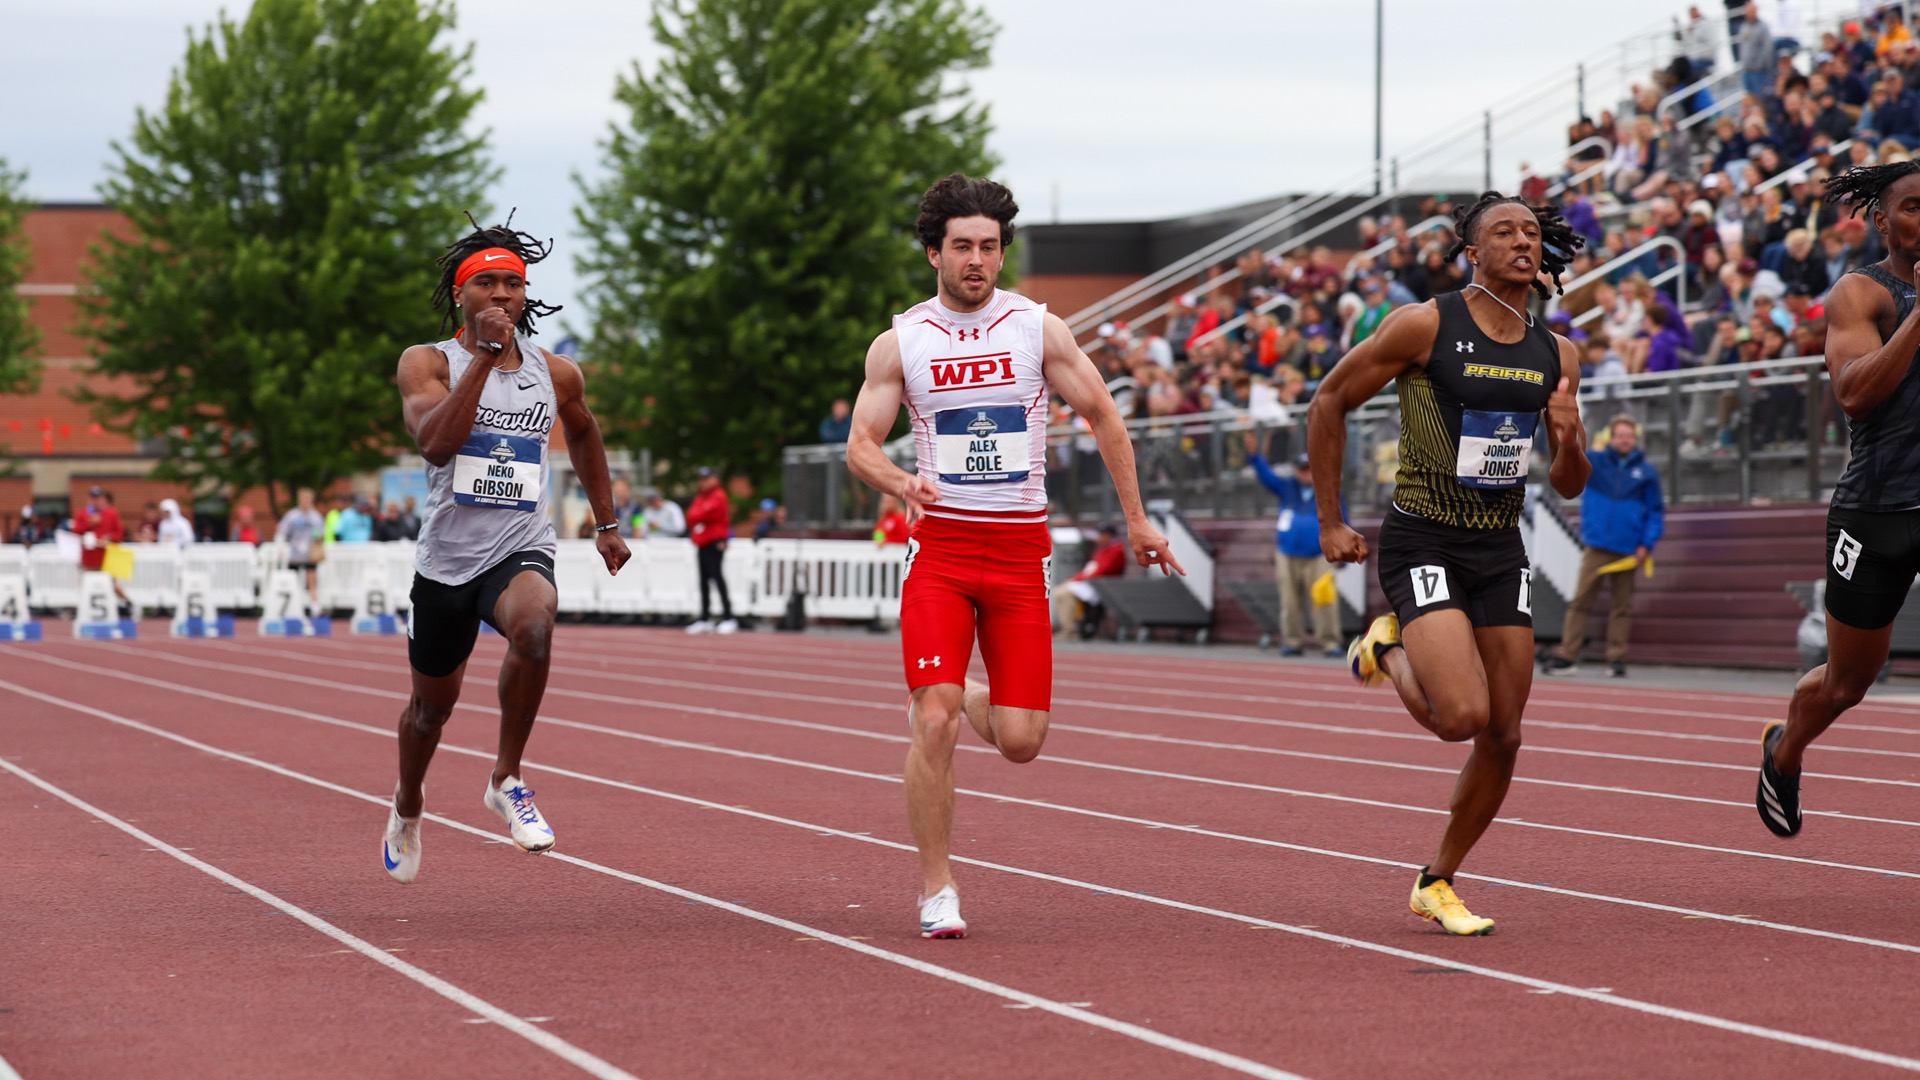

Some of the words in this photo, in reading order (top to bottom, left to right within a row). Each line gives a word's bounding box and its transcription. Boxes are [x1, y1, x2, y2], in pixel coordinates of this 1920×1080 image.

[930, 357, 1016, 387] WPI
[1463, 363, 1544, 385] PFEIFFER
[474, 401, 552, 434] reenville
[969, 439, 998, 453] ALEX
[1483, 444, 1523, 457] JORDAN
[487, 464, 514, 479] NEKO
[966, 455, 1003, 472] COLE
[1479, 460, 1519, 477] JONES
[473, 478, 524, 499] GIBSON
[1835, 537, 1854, 572] 5
[1418, 567, 1439, 600] 4
[1, 596, 18, 619] 4
[90, 594, 107, 620] 5
[187, 592, 204, 617] 6
[278, 592, 291, 617] 7
[367, 590, 385, 616] 8
